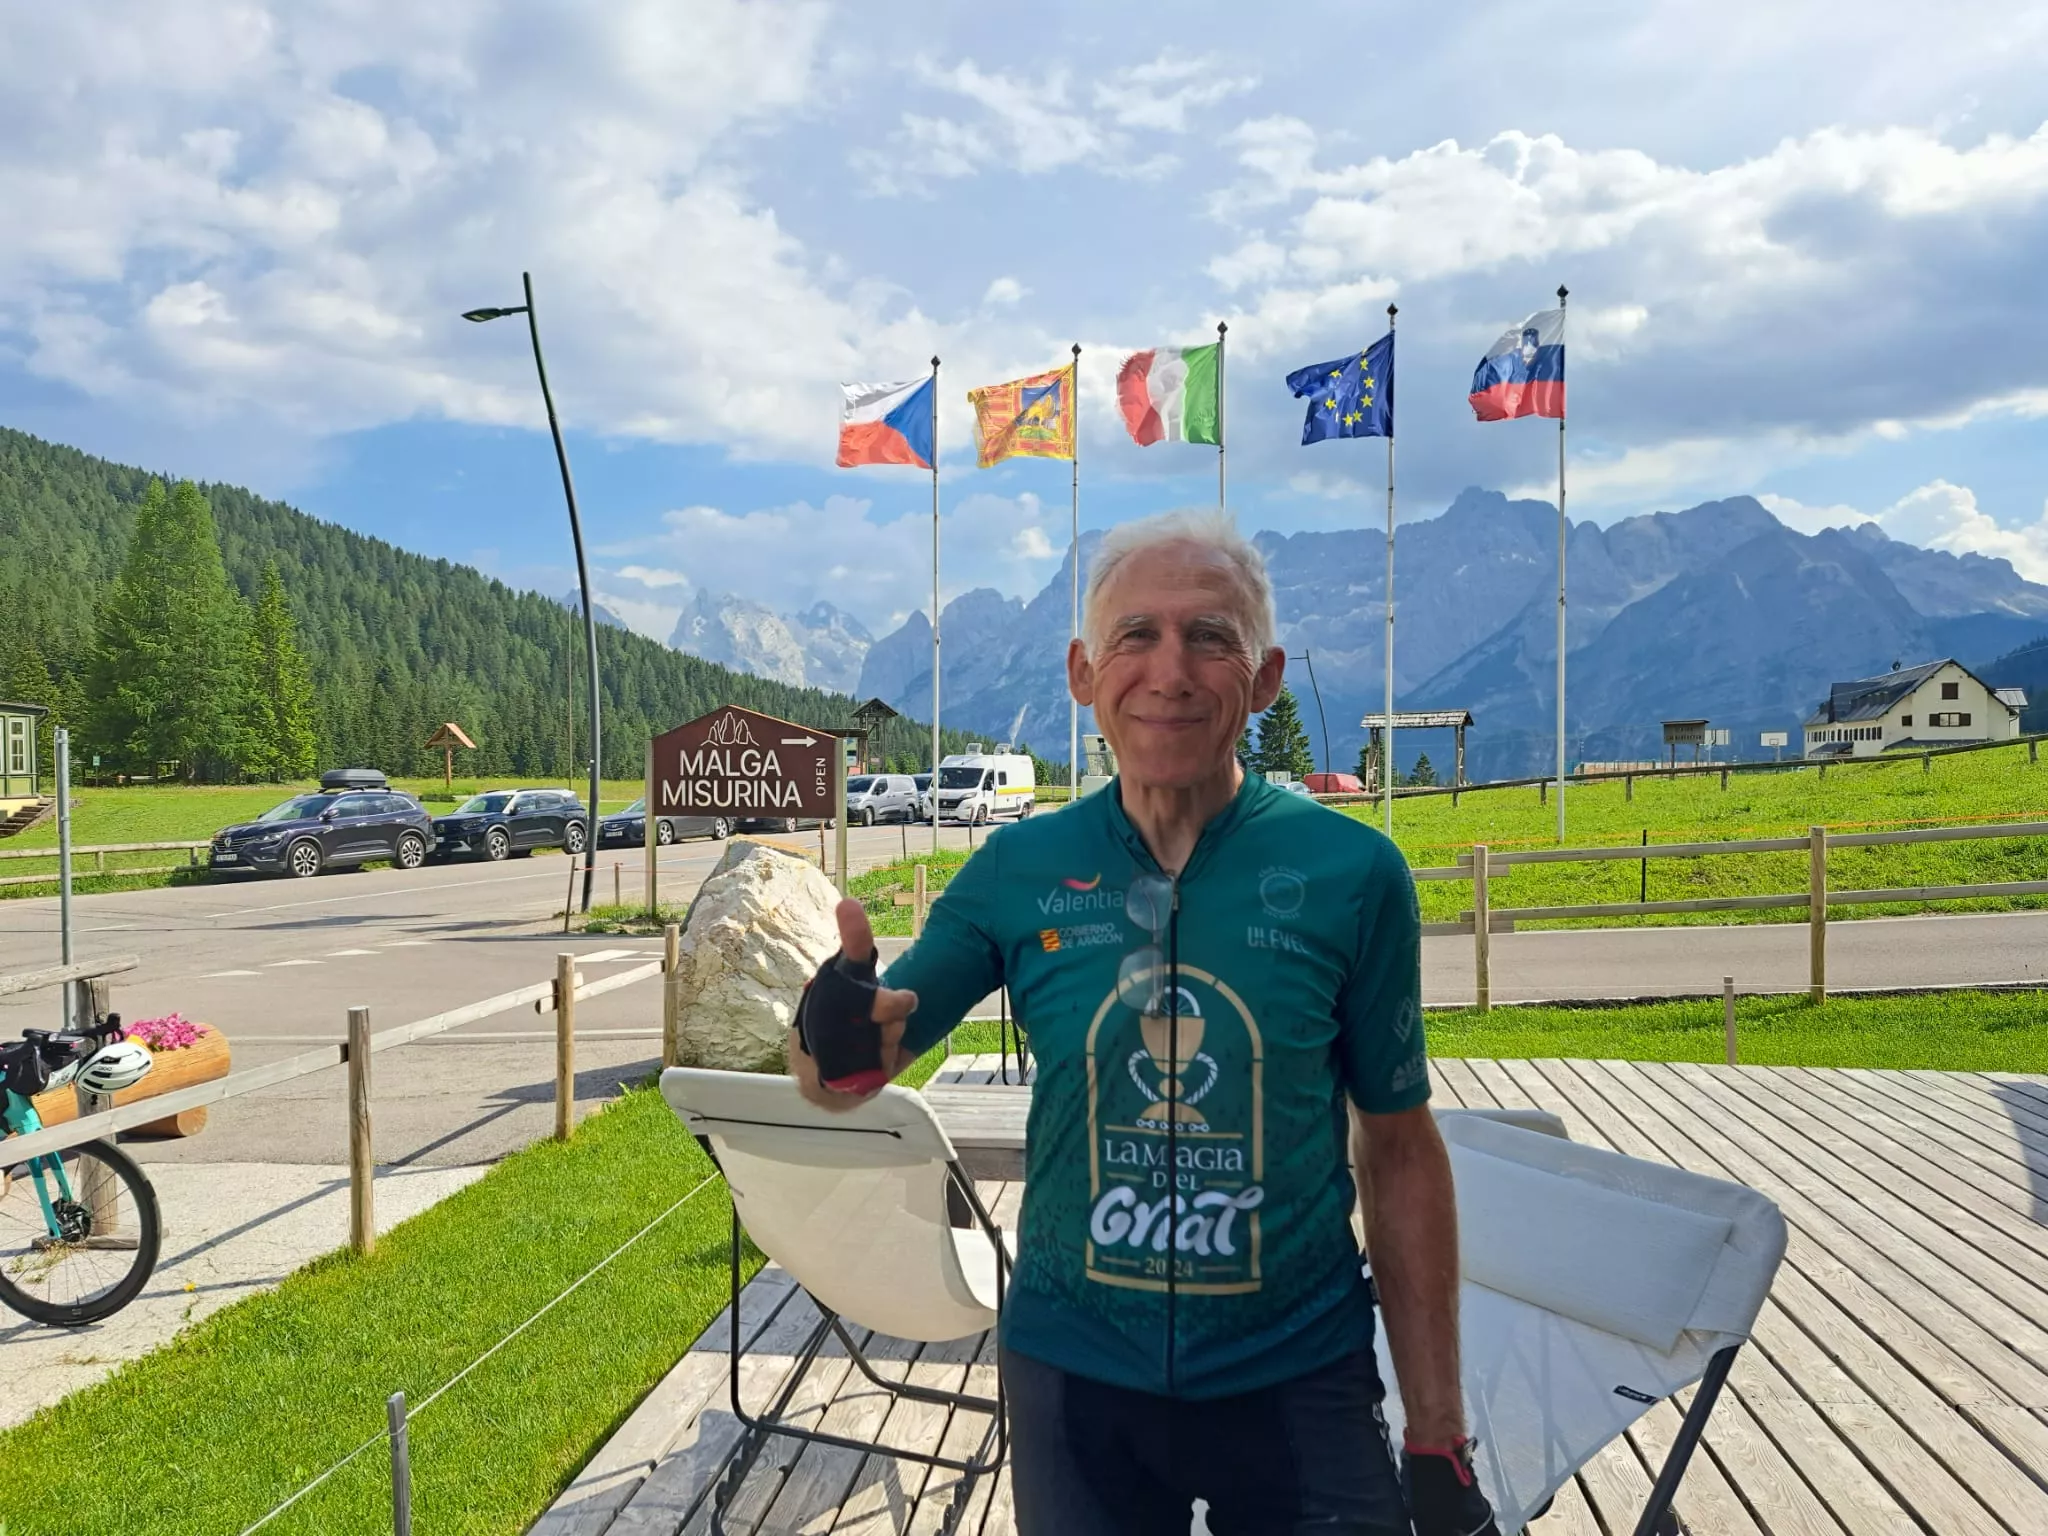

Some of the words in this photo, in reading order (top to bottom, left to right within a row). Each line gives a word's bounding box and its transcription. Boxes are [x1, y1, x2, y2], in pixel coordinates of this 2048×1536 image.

[679, 749, 782, 777] MALGA
[815, 757, 827, 797] OPEN
[662, 779, 803, 808] MISURINA
[1037, 886, 1124, 915] Valentia
[1144, 1258, 1194, 1278] 2024
